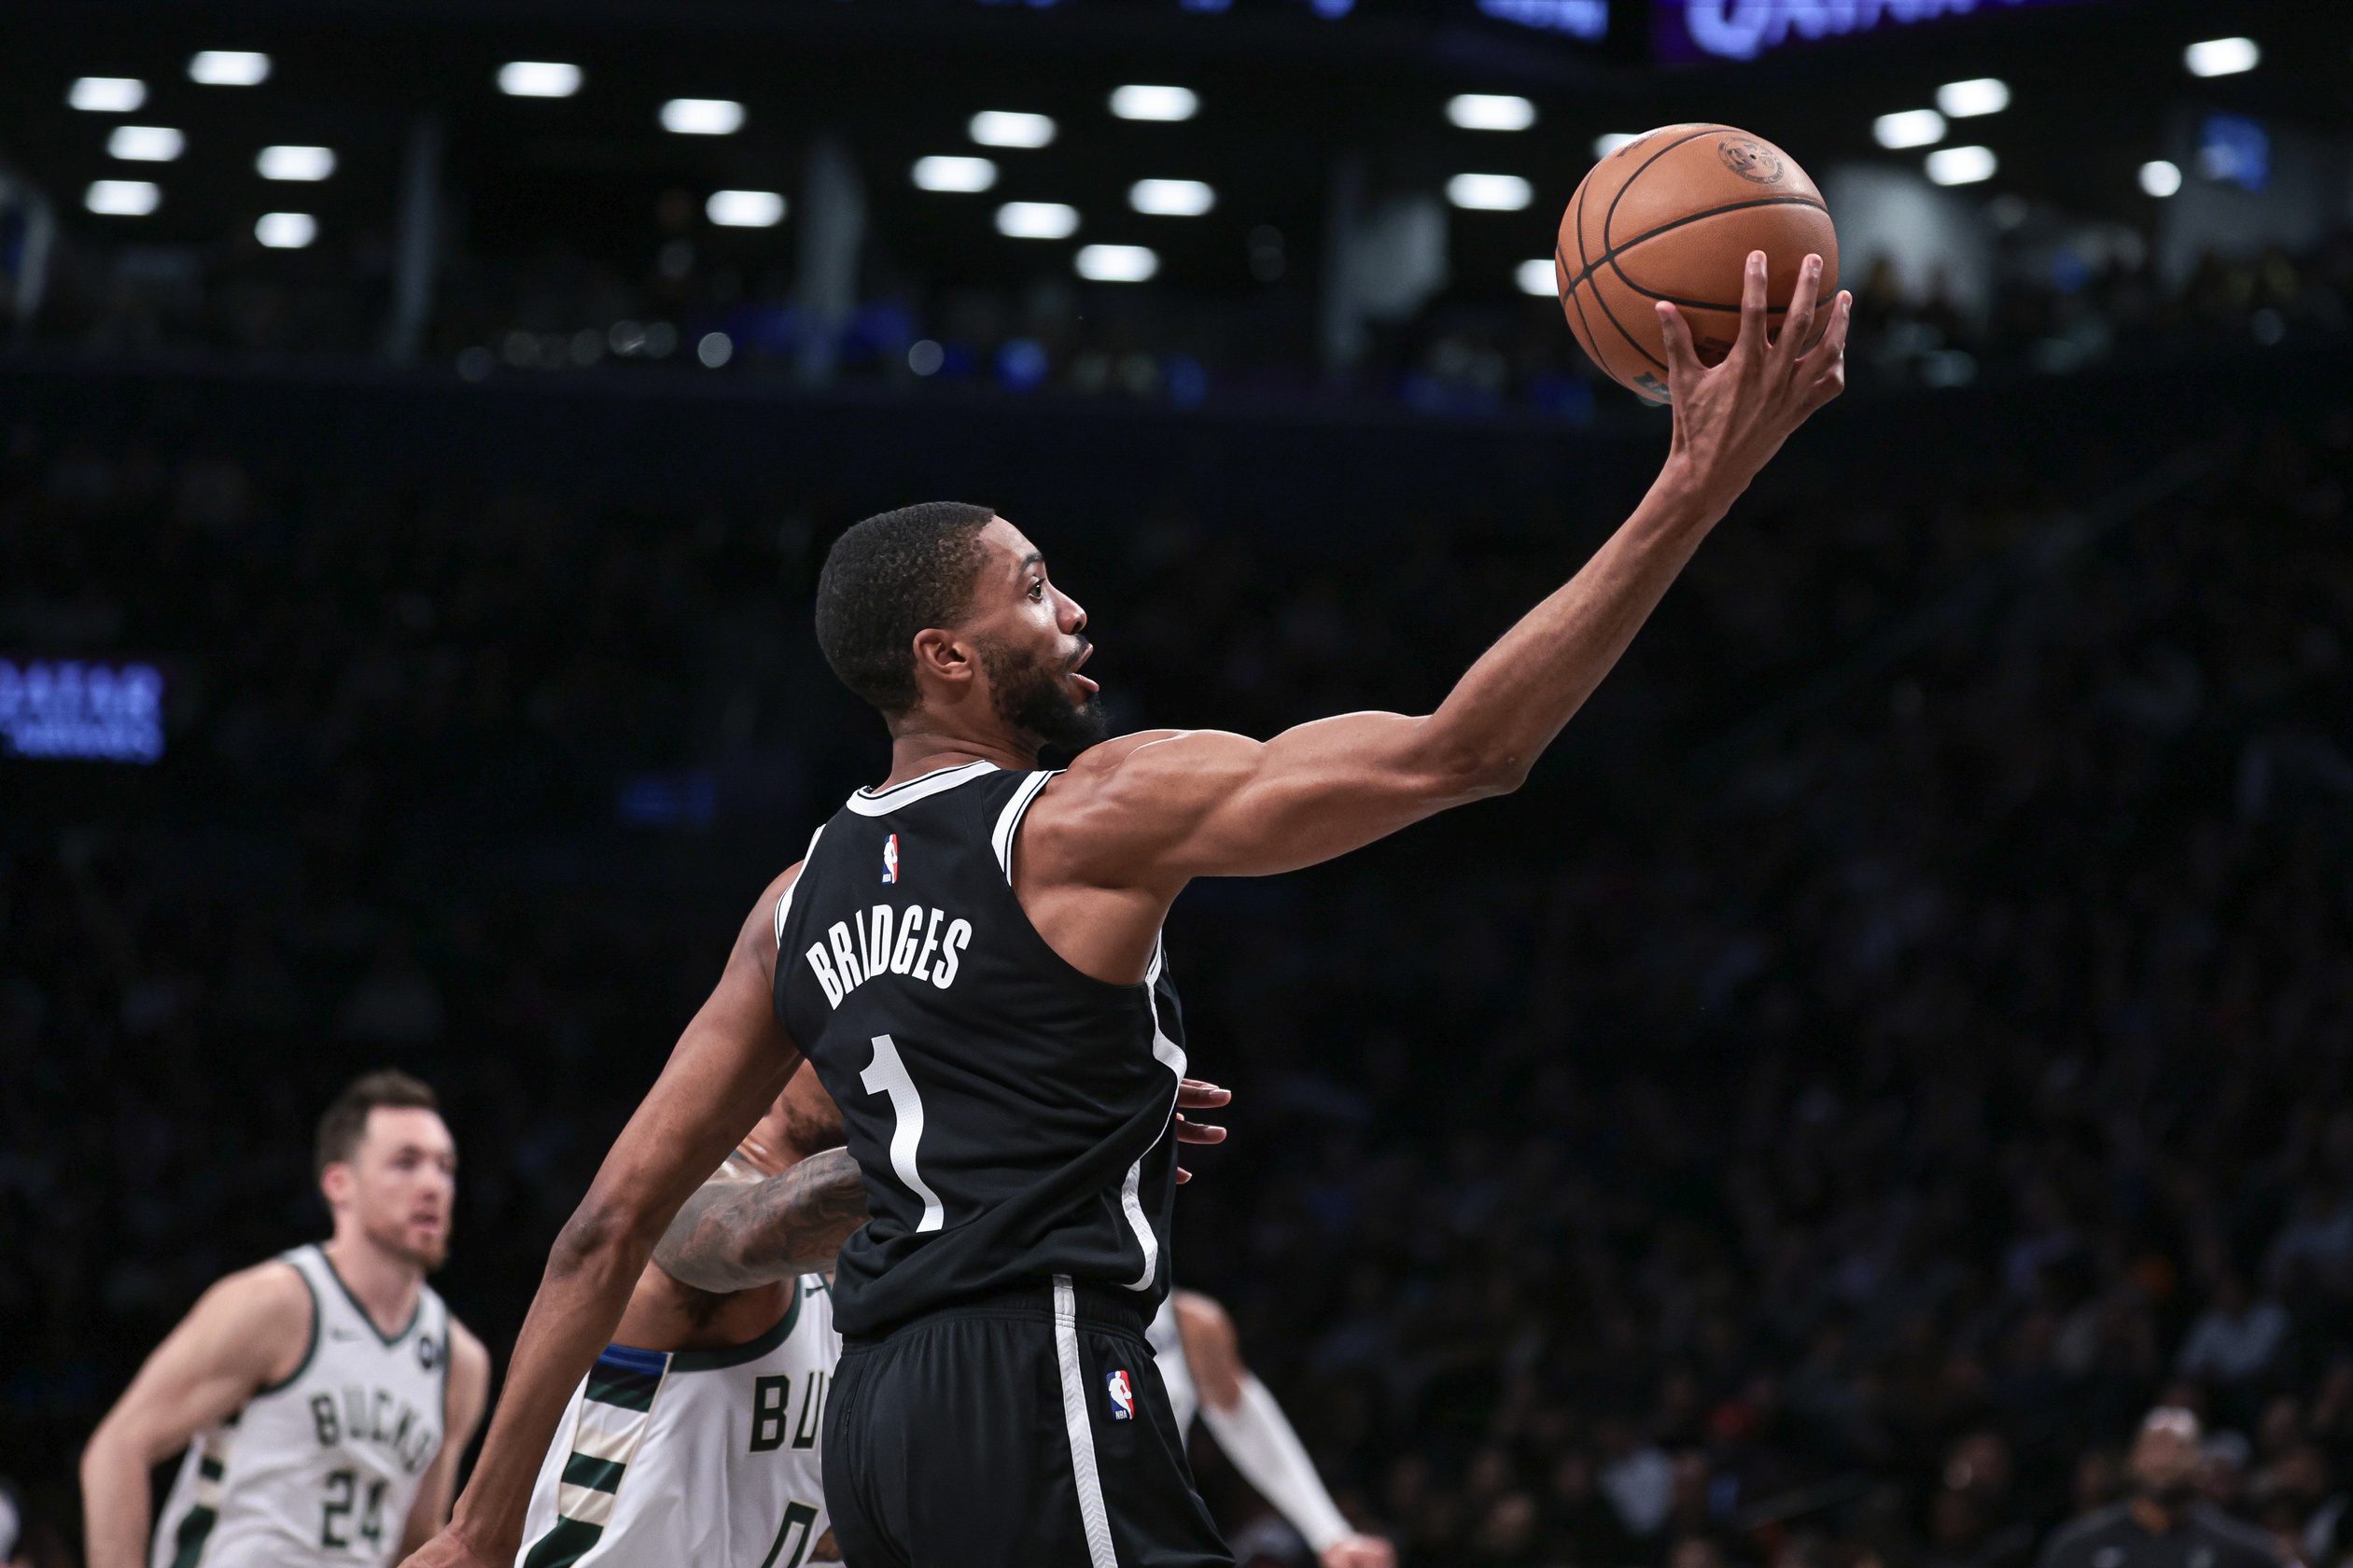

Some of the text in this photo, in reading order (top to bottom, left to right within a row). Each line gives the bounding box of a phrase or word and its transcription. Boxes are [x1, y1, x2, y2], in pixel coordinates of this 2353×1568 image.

[805, 903, 973, 1011] BRIDGES
[859, 1033, 945, 1234] 1
[749, 1370, 833, 1453] BU
[1114, 1409, 1127, 1421] NBA
[321, 1466, 390, 1551] 24
